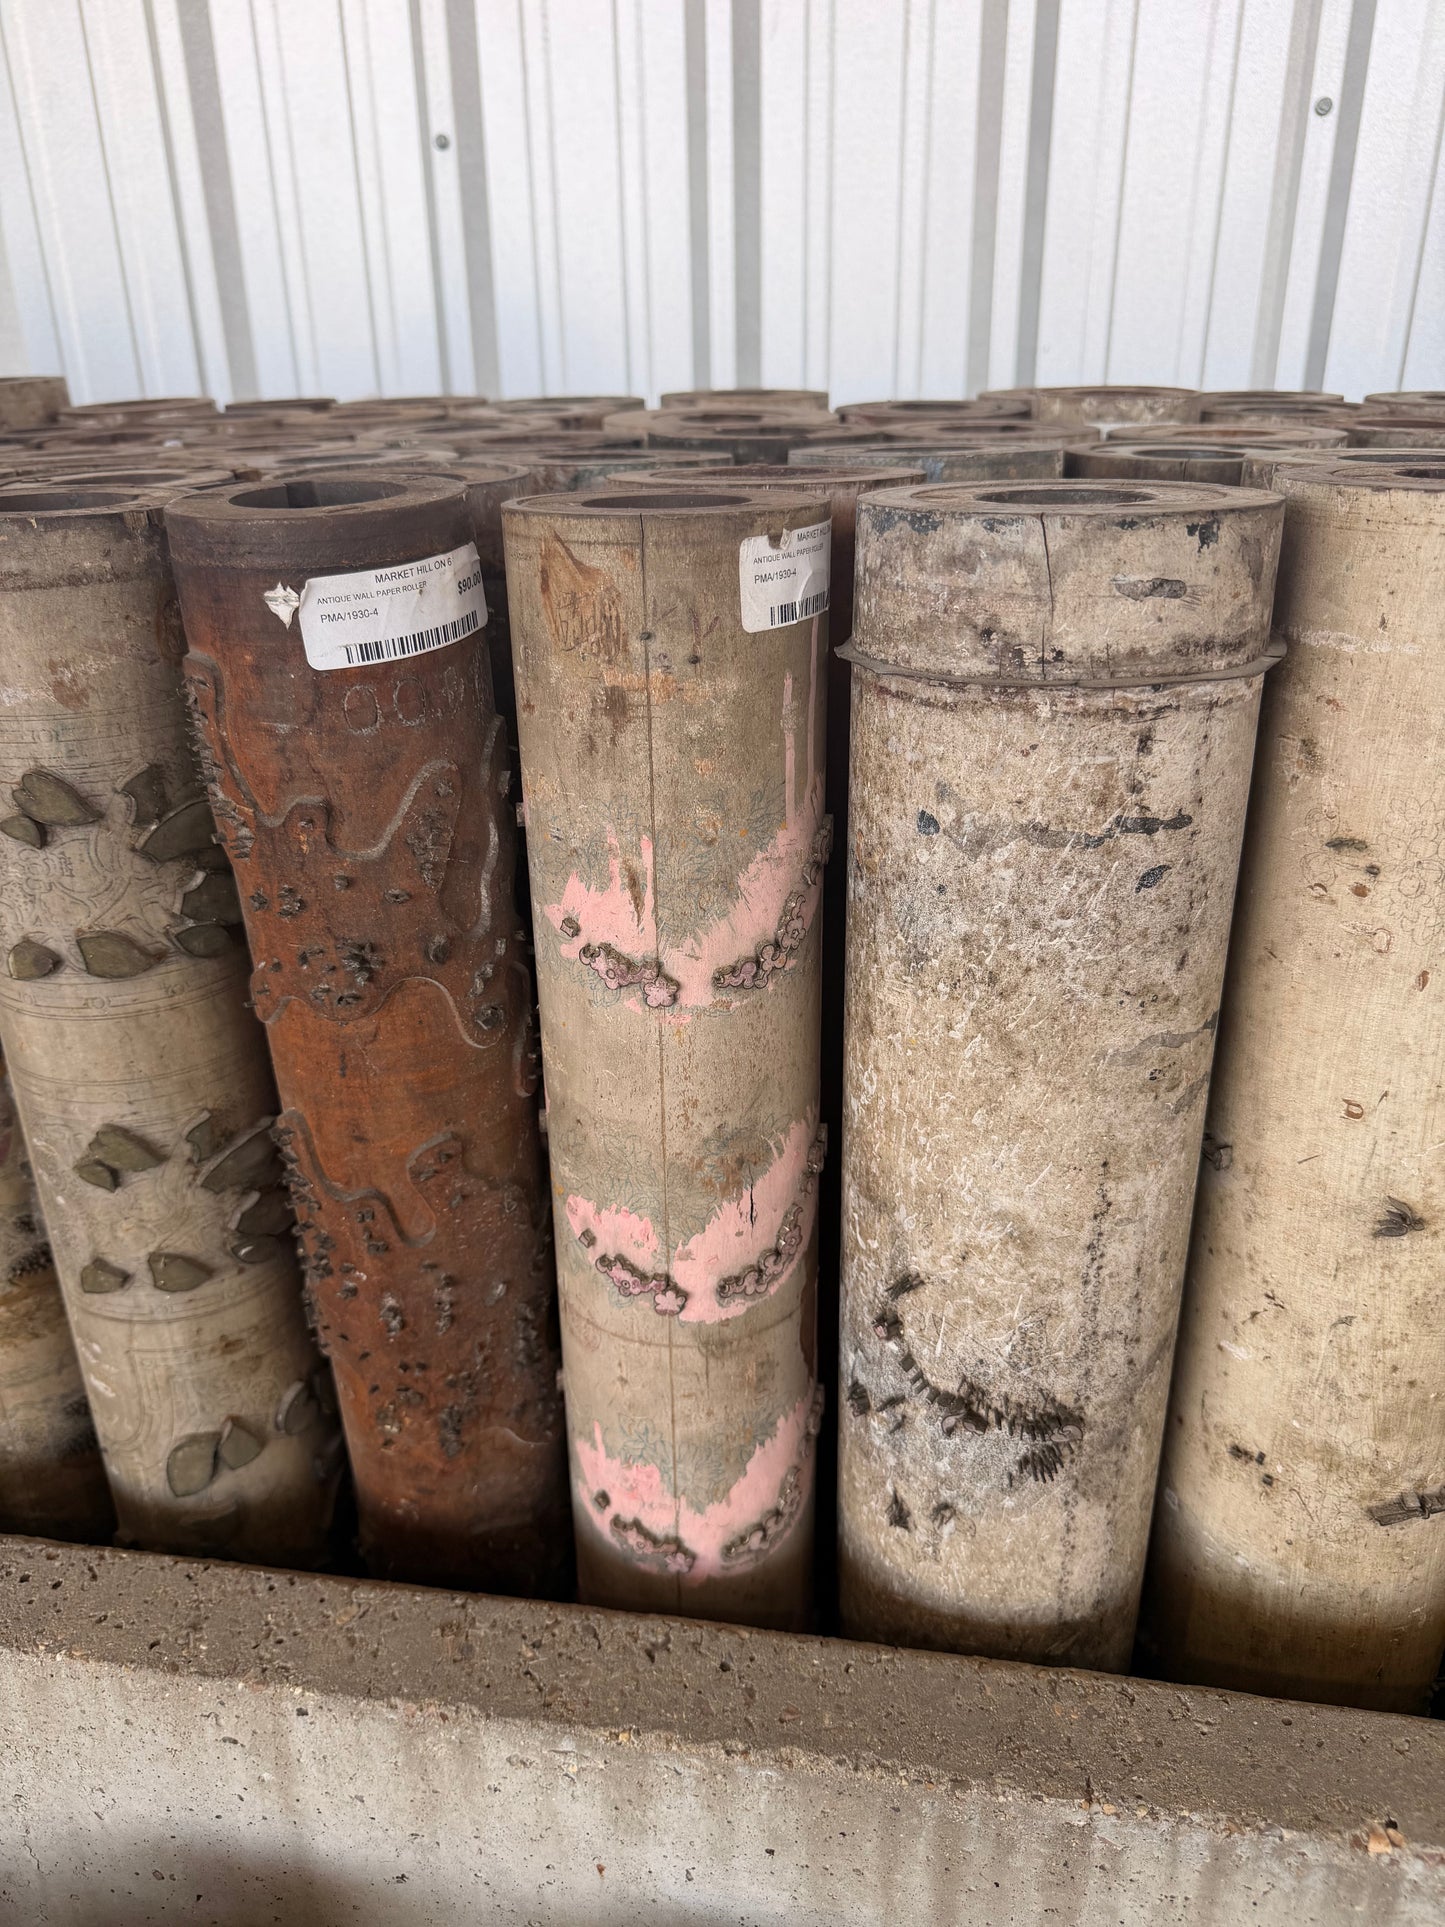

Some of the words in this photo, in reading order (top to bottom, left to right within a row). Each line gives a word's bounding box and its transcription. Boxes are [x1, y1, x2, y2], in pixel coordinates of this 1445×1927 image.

[797, 528, 819, 542] MARKET
[753, 554, 780, 565] ANTIQUE
[781, 551, 796, 560] WALL
[375, 568, 414, 583] MARKET
[416, 563, 433, 576] HILL
[434, 560, 446, 570] ON
[754, 568, 797, 584] PMA/1930-4
[457, 570, 482, 595] $90.00
[317, 594, 352, 606] ANTIQUE
[353, 592, 375, 601] WALL
[376, 587, 401, 597] PAPER
[402, 581, 427, 593] ROLLER
